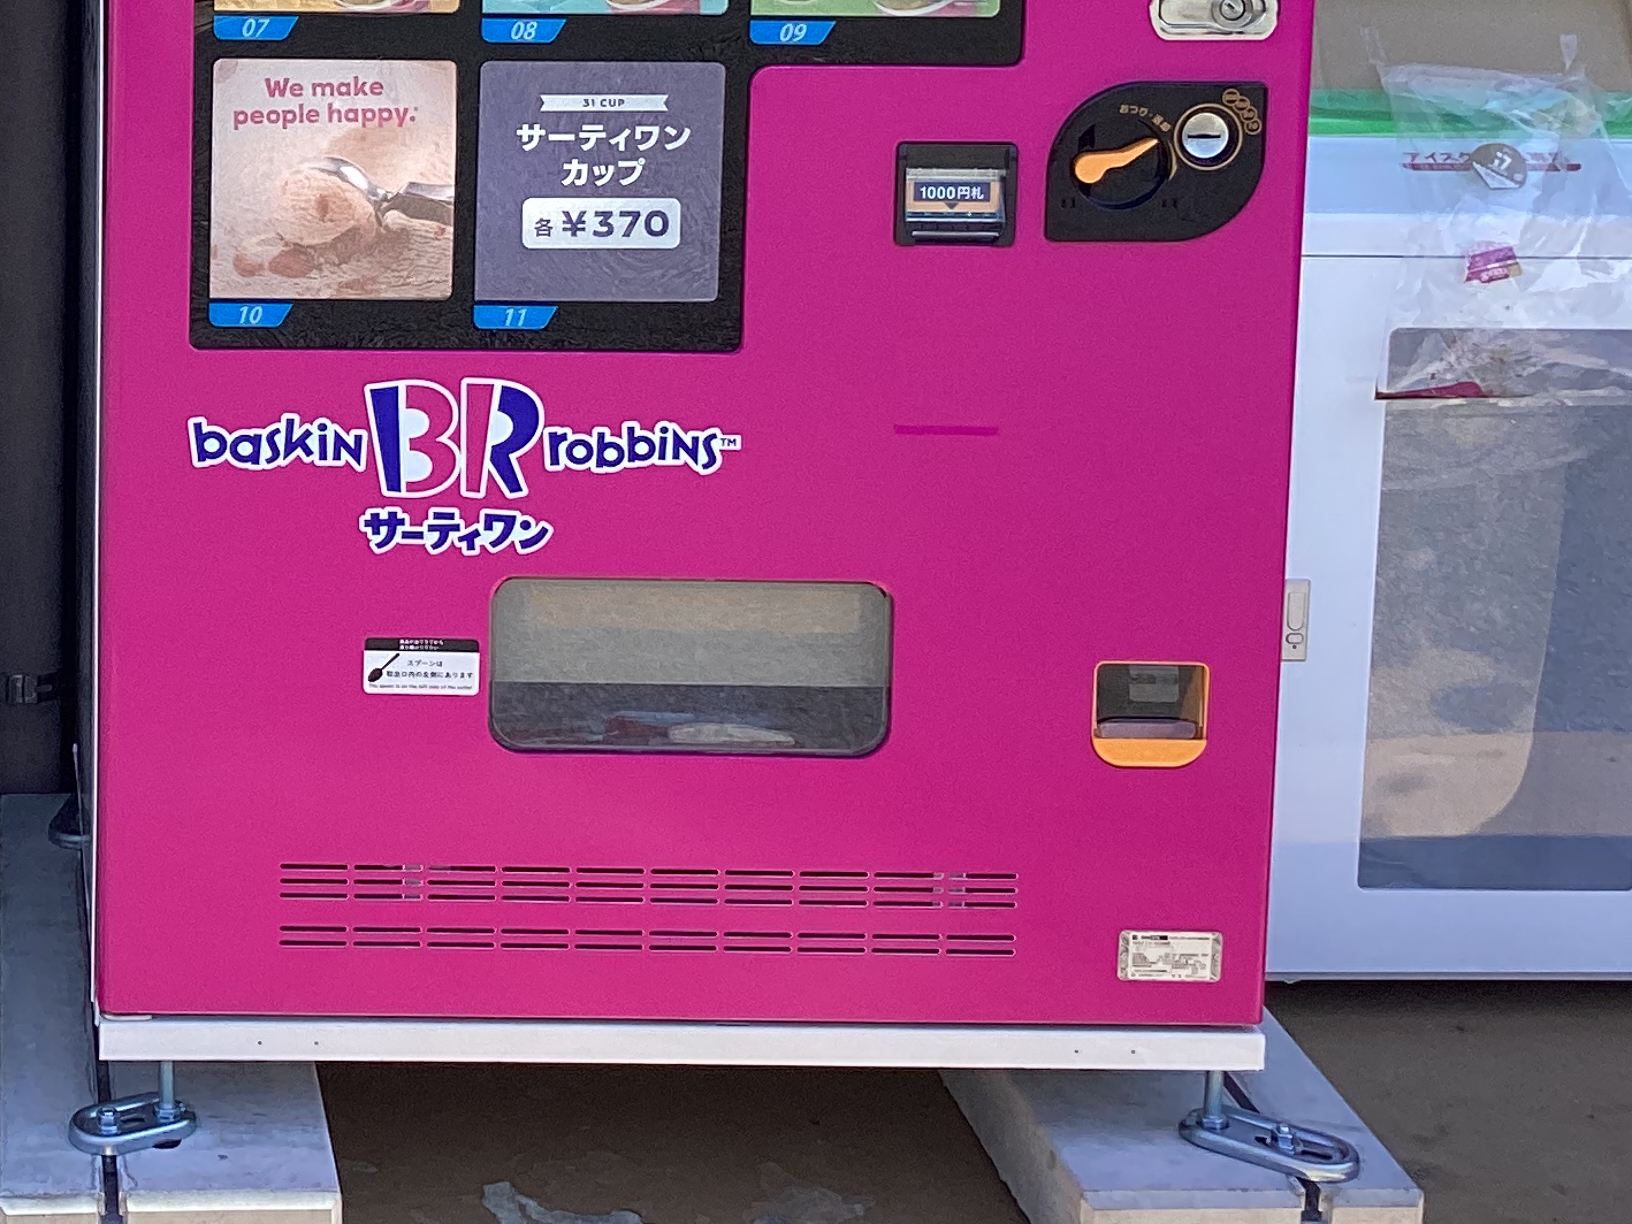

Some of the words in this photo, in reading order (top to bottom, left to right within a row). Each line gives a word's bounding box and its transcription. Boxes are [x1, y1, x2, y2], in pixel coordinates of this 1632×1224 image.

[242, 18, 270, 38] 07
[510, 21, 538, 40] 08
[779, 23, 808, 43] 09
[264, 77, 304, 98] We
[311, 75, 384, 97] make
[582, 98, 595, 108] 31
[600, 98, 626, 108] CUP
[232, 103, 320, 130] people
[516, 123, 692, 152] サーティワン
[560, 157, 647, 187] カップ
[918, 185, 985, 202] 1000円札
[561, 209, 670, 238] ¥370
[238, 305, 264, 325] 10
[504, 307, 528, 327] 11
[190, 417, 364, 467] baskin
[366, 378, 542, 498] BR
[547, 423, 720, 472] robbins
[362, 509, 550, 552] サーティワン
